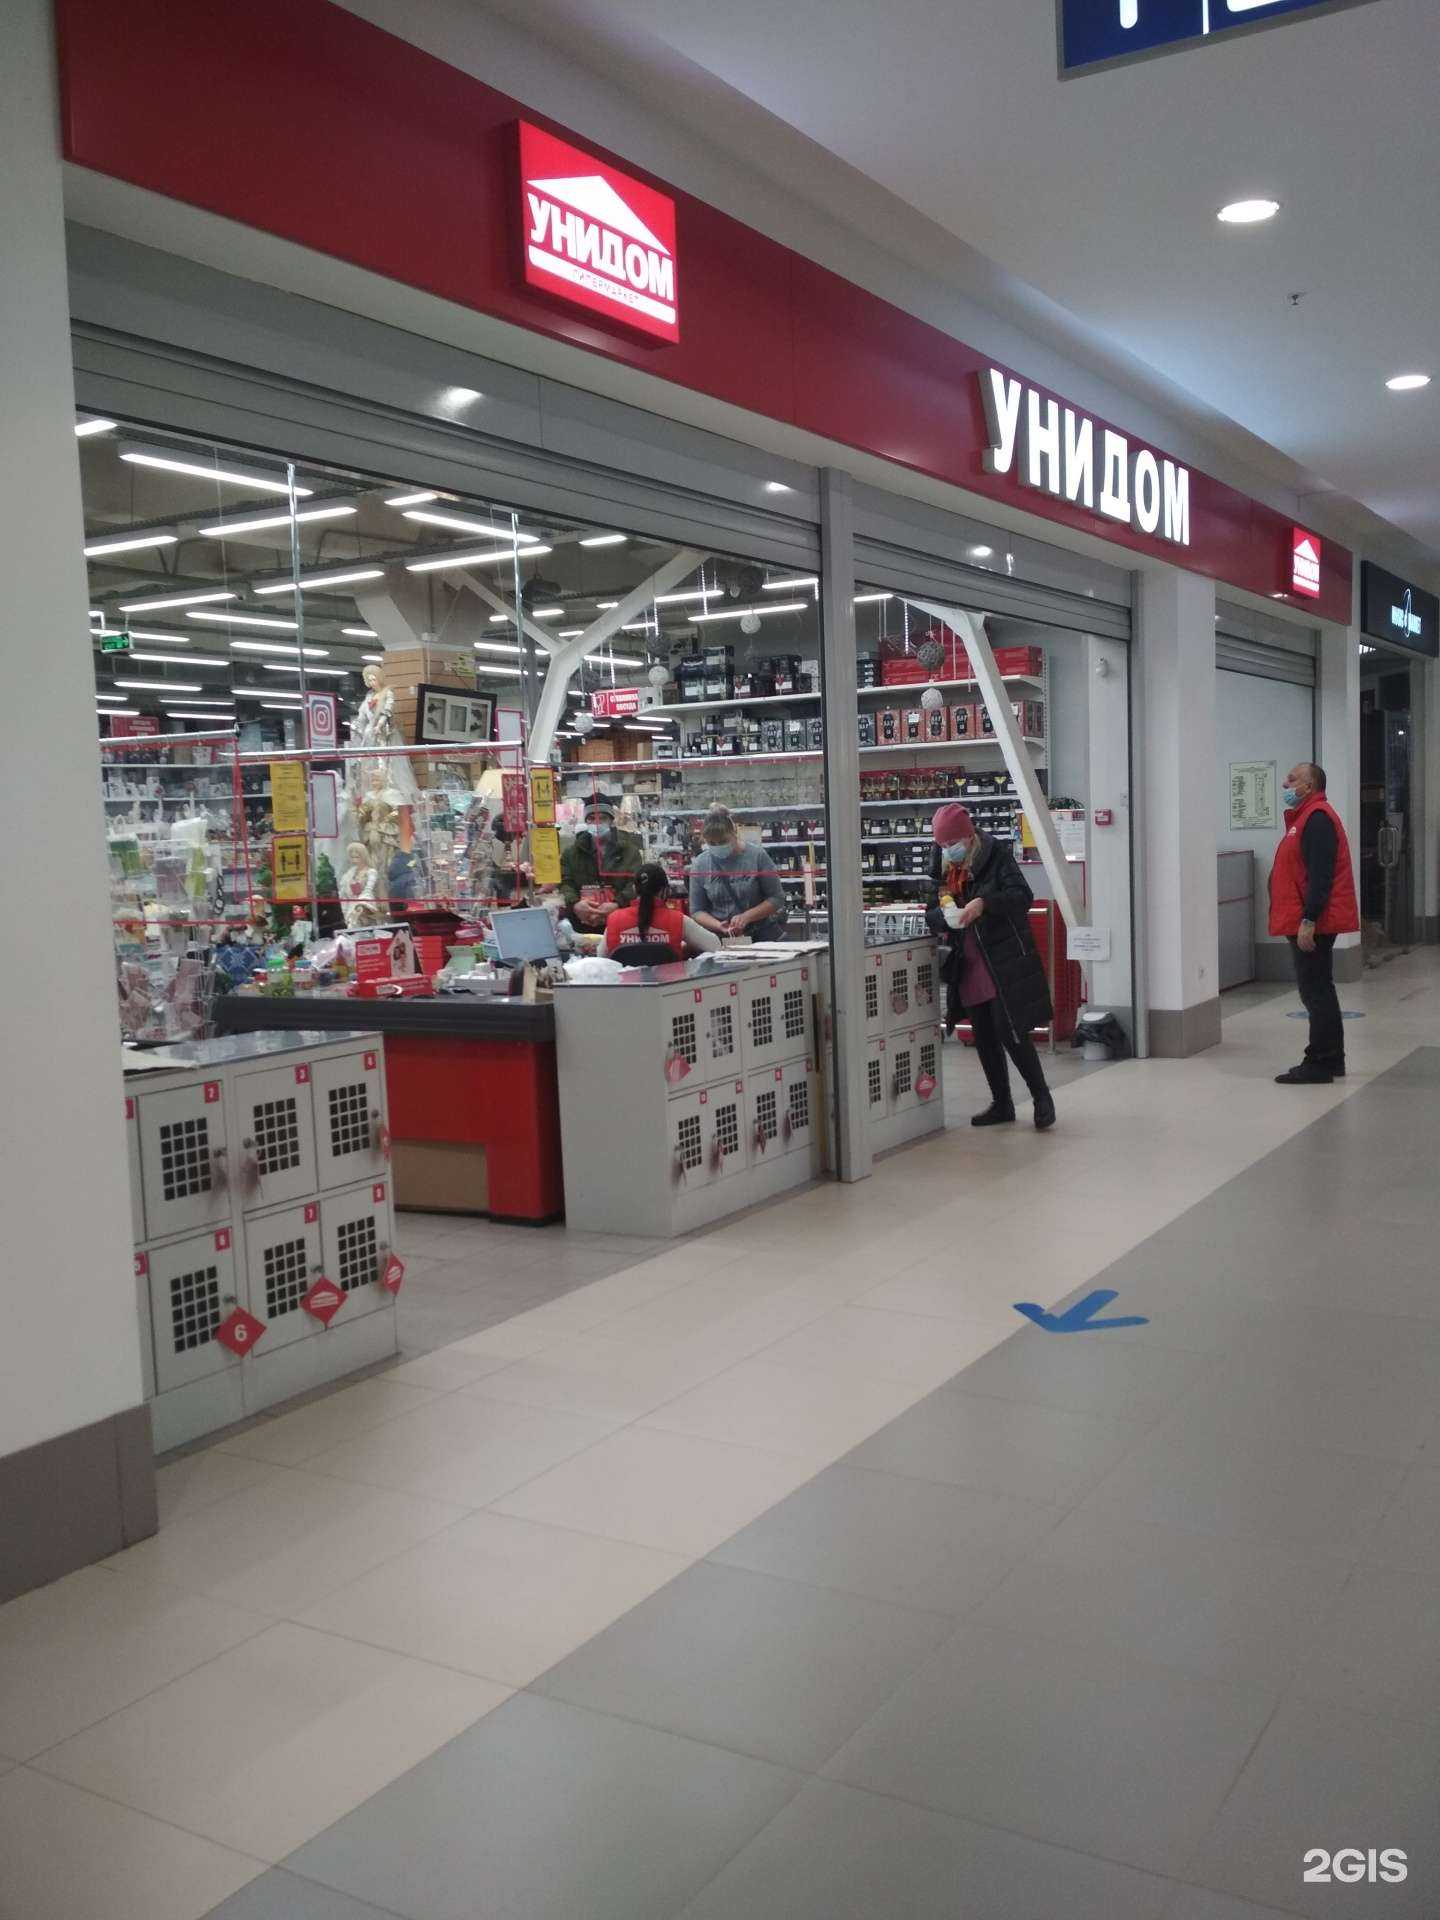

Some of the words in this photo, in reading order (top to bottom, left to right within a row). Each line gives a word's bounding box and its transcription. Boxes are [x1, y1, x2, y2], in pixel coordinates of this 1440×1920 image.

[527, 192, 675, 300] УНИДОМ
[986, 368, 1190, 546] УНИДОМ
[234, 1324, 247, 1341] 6
